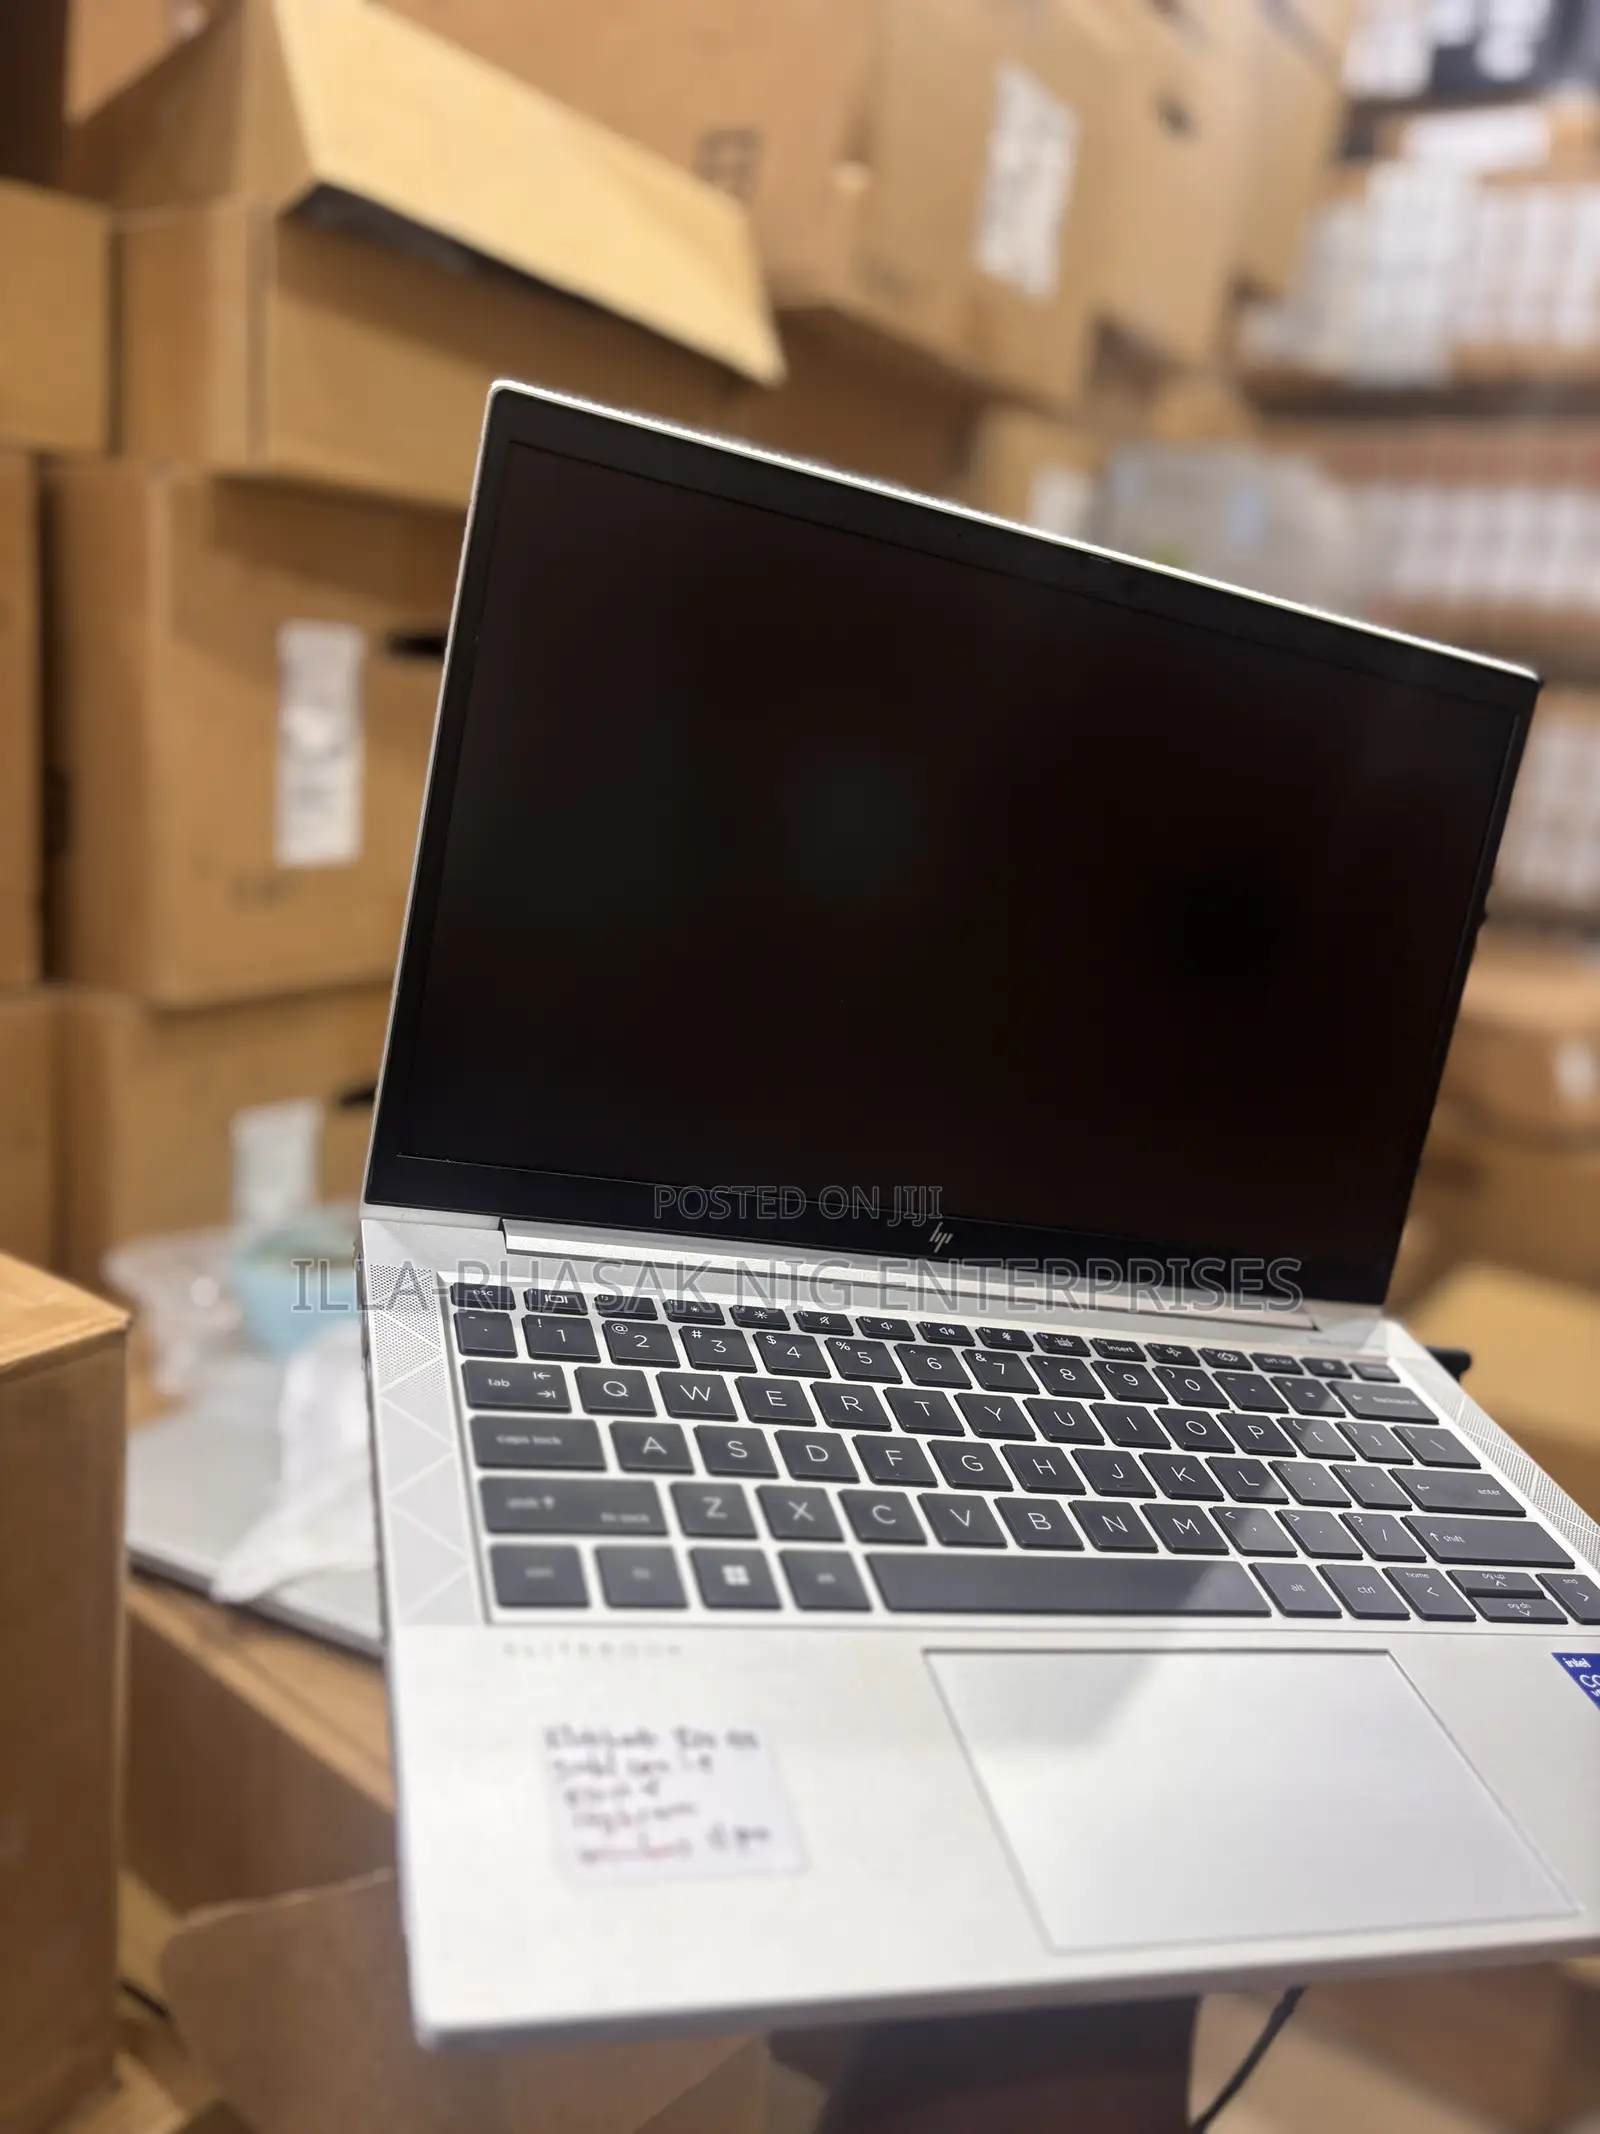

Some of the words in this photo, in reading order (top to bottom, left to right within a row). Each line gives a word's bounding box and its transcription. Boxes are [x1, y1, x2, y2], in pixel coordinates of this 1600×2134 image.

[556, 1329, 566, 1342] 1
[611, 1323, 628, 1335] @
[691, 1329, 702, 1339] #
[633, 1335, 650, 1348] 2
[711, 1340, 727, 1353] 3
[766, 1334, 777, 1345] $
[835, 1341, 851, 1351] %
[786, 1346, 801, 1359] 4
[1107, 1345, 1135, 1353] insert
[857, 1352, 873, 1365] 5
[926, 1357, 942, 1370] 6
[975, 1353, 987, 1363] &
[993, 1363, 1005, 1375] 7
[1059, 1369, 1076, 1381] 8
[488, 1378, 510, 1386] tab
[1123, 1374, 1139, 1386] 9
[603, 1381, 629, 1397] Q
[680, 1384, 711, 1402] W
[766, 1390, 787, 1407] E
[841, 1396, 863, 1411] R
[914, 1401, 930, 1416] T
[984, 1406, 1001, 1421] Y
[1053, 1411, 1075, 1426] U
[1185, 1421, 1207, 1435] O
[1247, 1425, 1264, 1439] P
[643, 1437, 667, 1454] A
[727, 1441, 748, 1458] S
[806, 1445, 828, 1461] D
[886, 1450, 903, 1466] F
[961, 1455, 984, 1472] G
[1033, 1459, 1057, 1475] H
[1112, 1464, 1124, 1478] J
[1171, 1467, 1195, 1482] K
[1238, 1471, 1259, 1486] L
[1477, 1488, 1500, 1496] enter
[703, 1497, 728, 1518] Z
[789, 1501, 814, 1521] X
[872, 1505, 896, 1524] C
[950, 1509, 970, 1527] V
[1028, 1512, 1051, 1530] B
[1102, 1515, 1128, 1532] N
[1172, 1518, 1200, 1535] M
[1443, 1534, 1465, 1543] shift
[1407, 1571, 1430, 1579] home
[1291, 1583, 1306, 1592] alt
[1357, 1585, 1376, 1594] ctrl
[1564, 1657, 1591, 1668] intel
